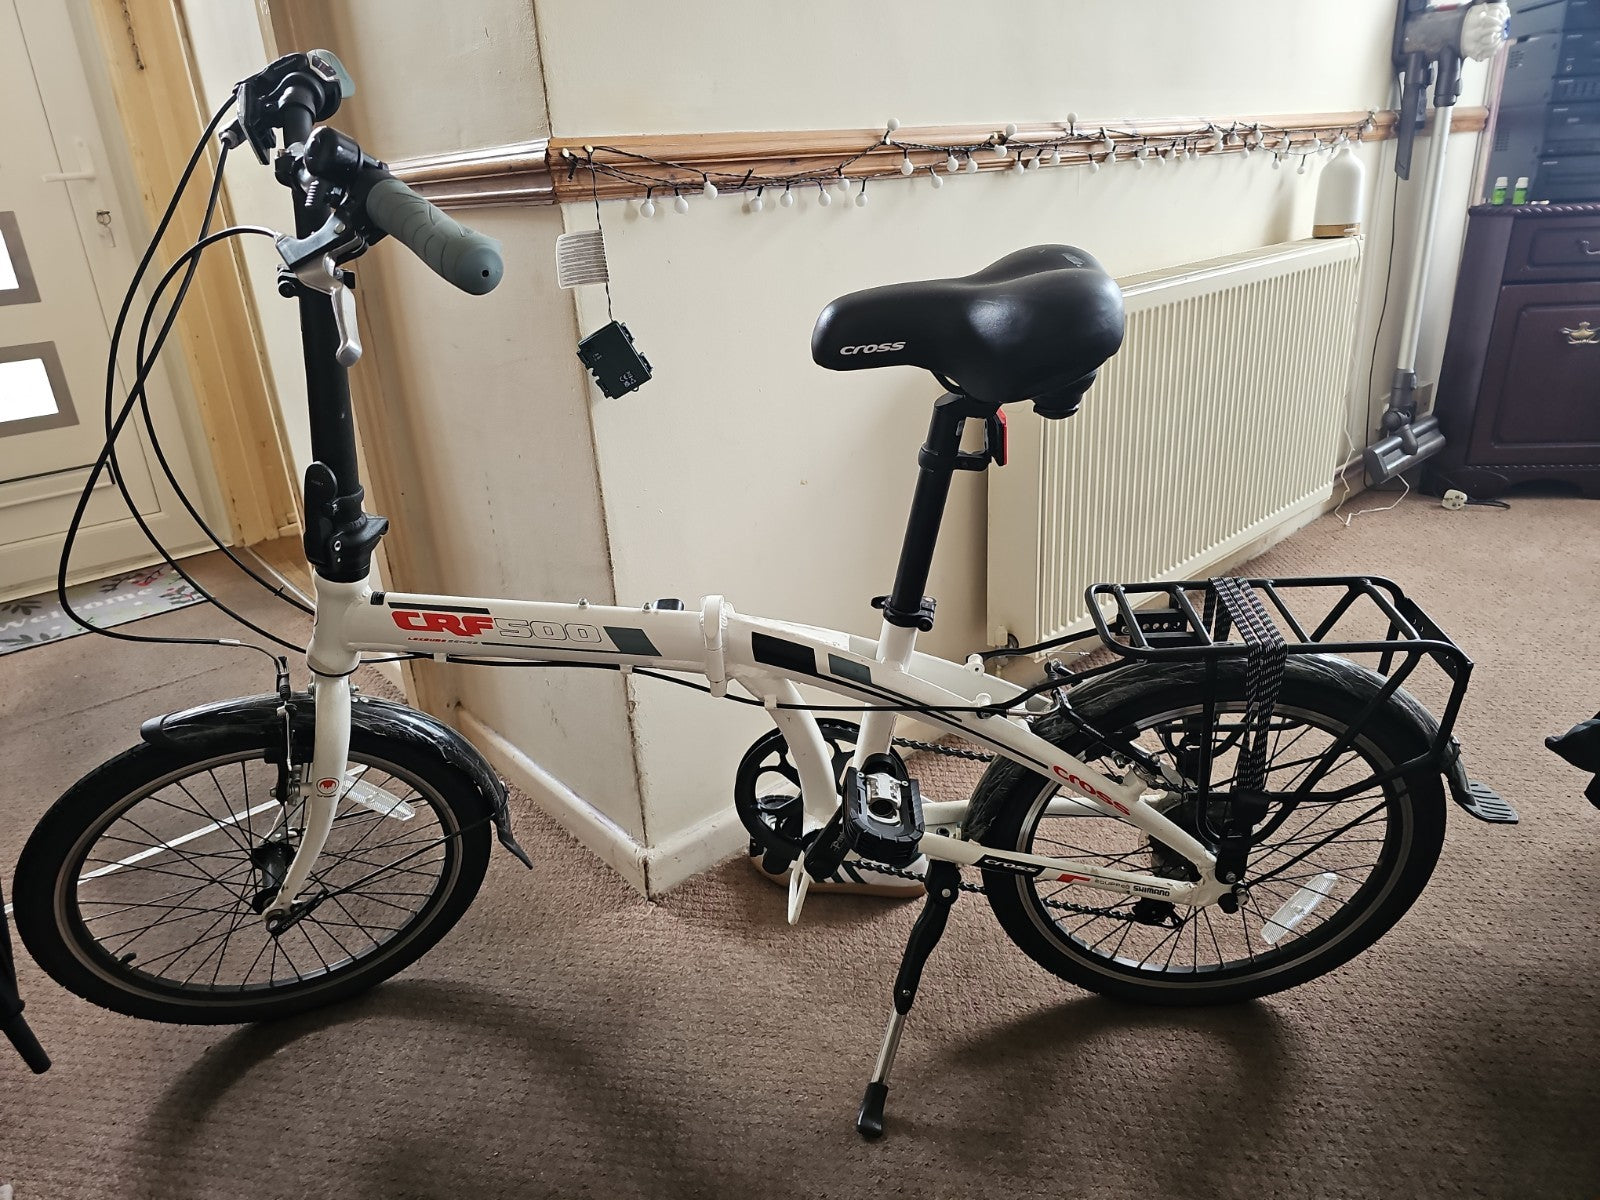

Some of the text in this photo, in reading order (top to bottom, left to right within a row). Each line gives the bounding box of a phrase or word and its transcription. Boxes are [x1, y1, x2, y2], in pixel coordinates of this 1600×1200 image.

[840, 341, 906, 355] cross
[1053, 765, 1131, 816] cross
[984, 859, 1038, 873] cross
[1132, 885, 1170, 897] SHIMANO
